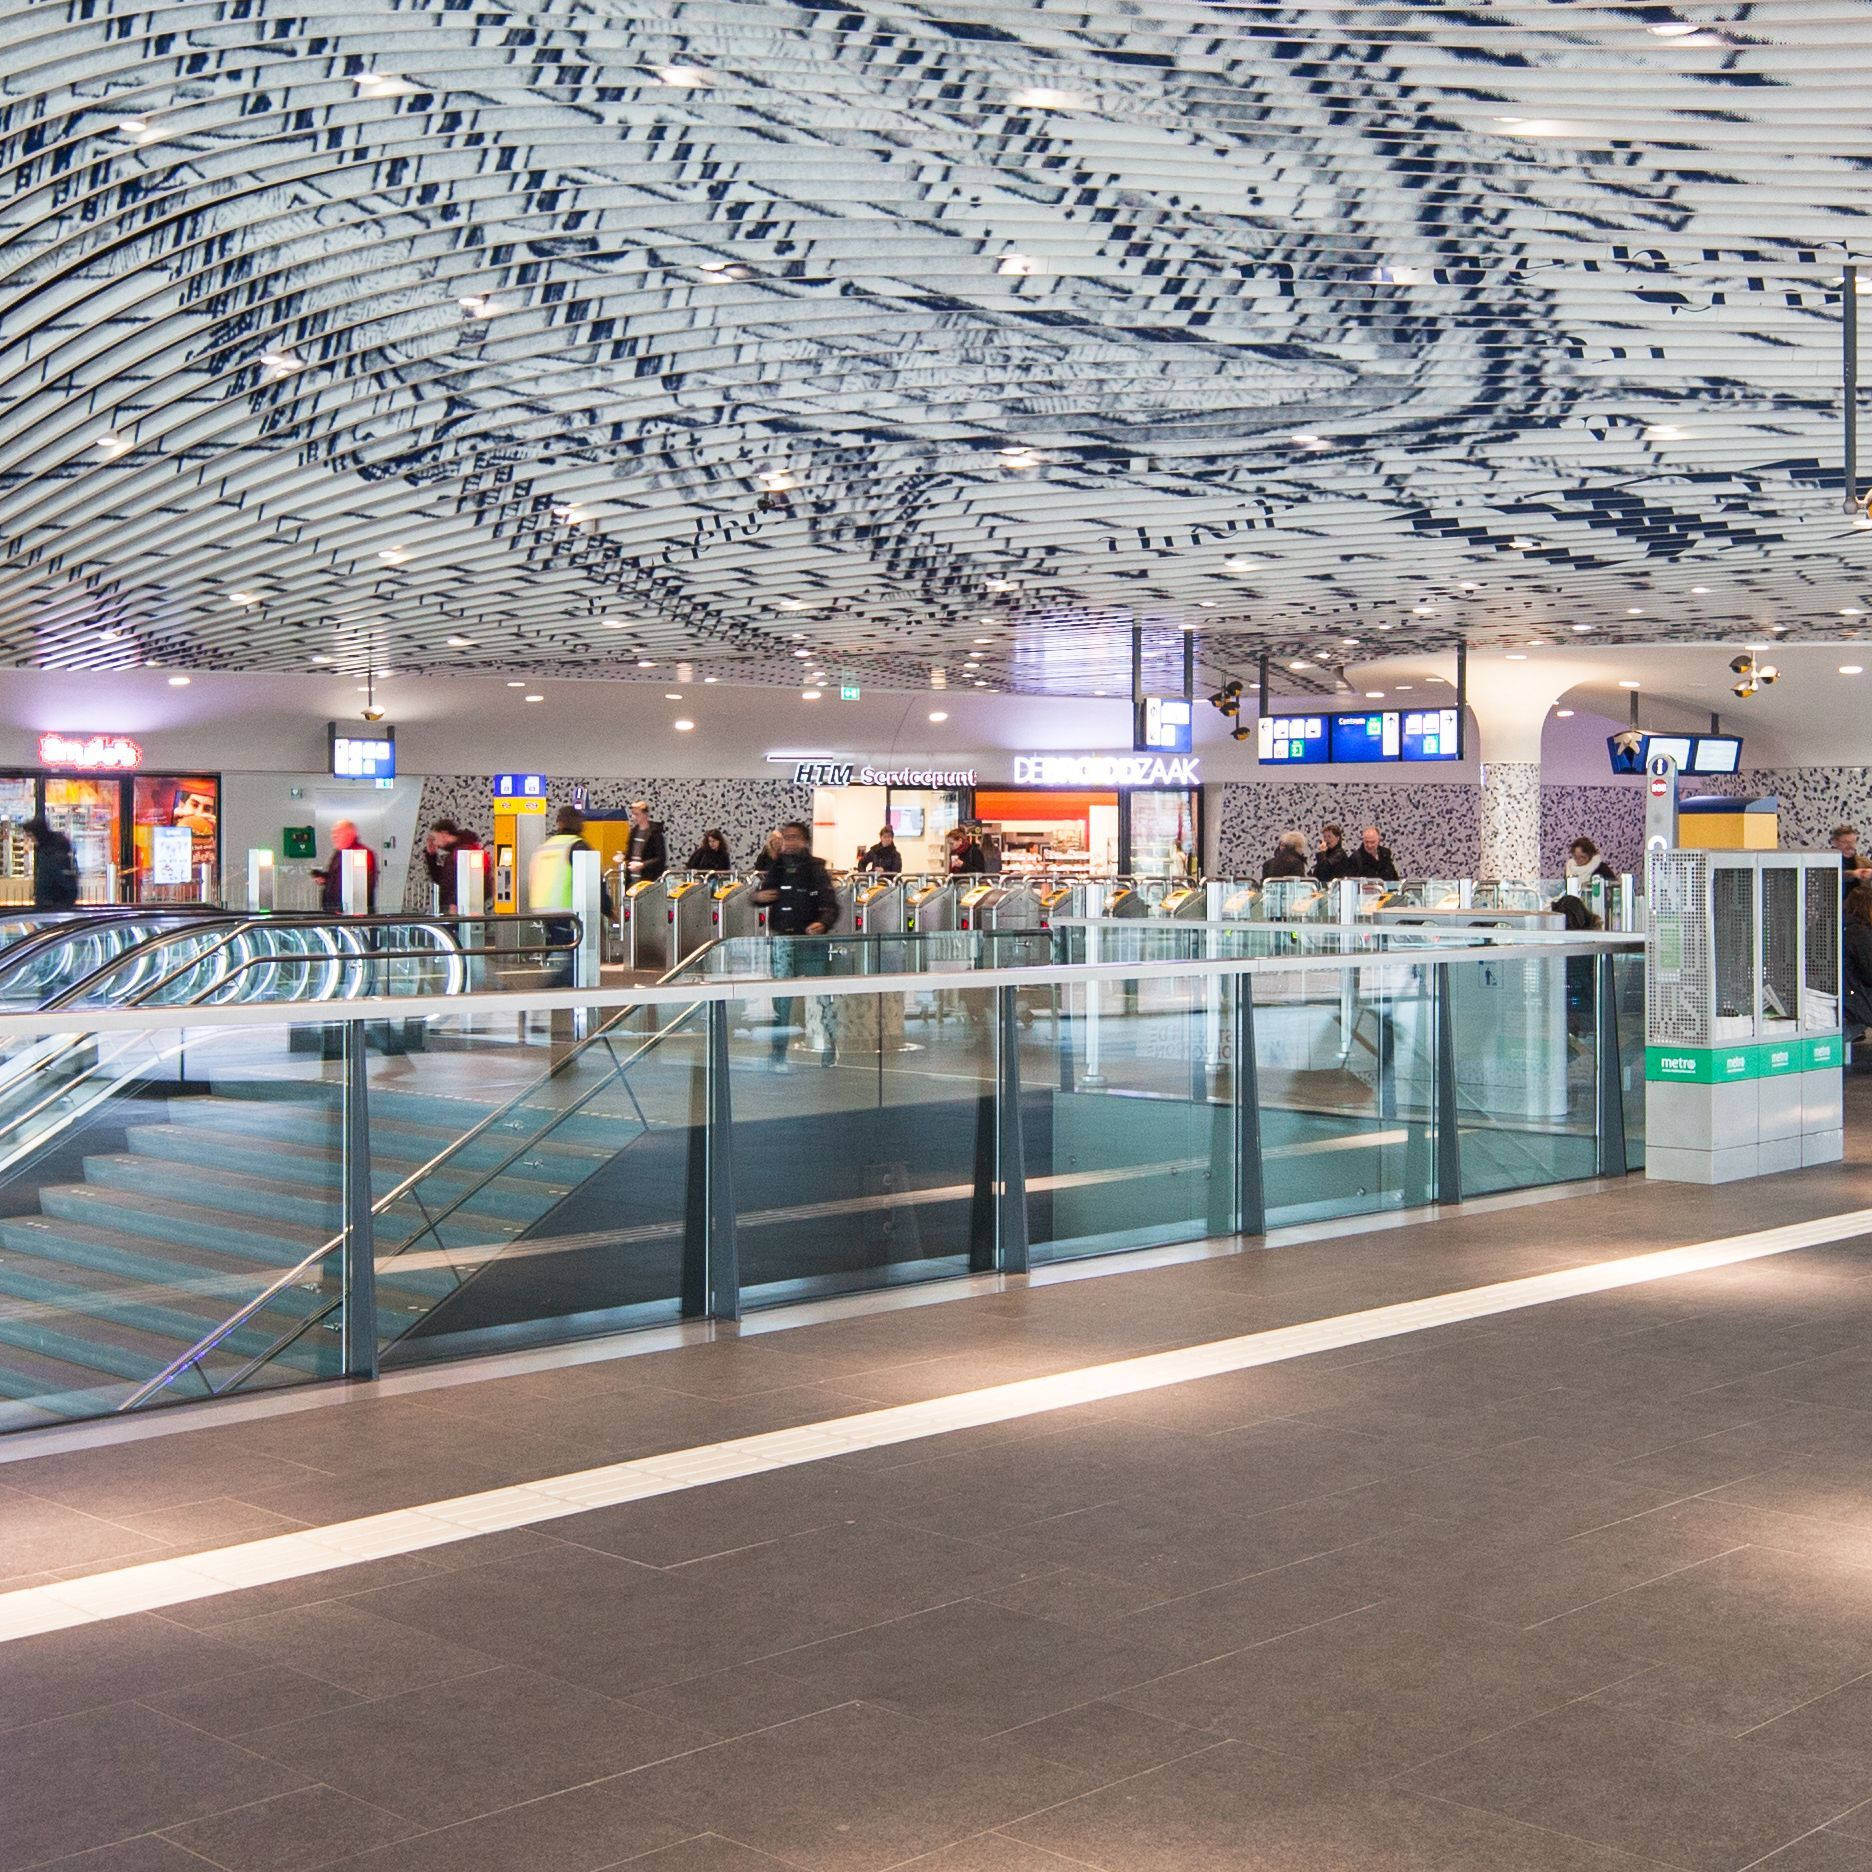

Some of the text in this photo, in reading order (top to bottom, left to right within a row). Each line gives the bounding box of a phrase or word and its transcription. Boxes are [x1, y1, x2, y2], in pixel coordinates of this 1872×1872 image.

[794, 762, 978, 790] HTM Servicepunt
[1661, 1057, 1697, 1070] metro
